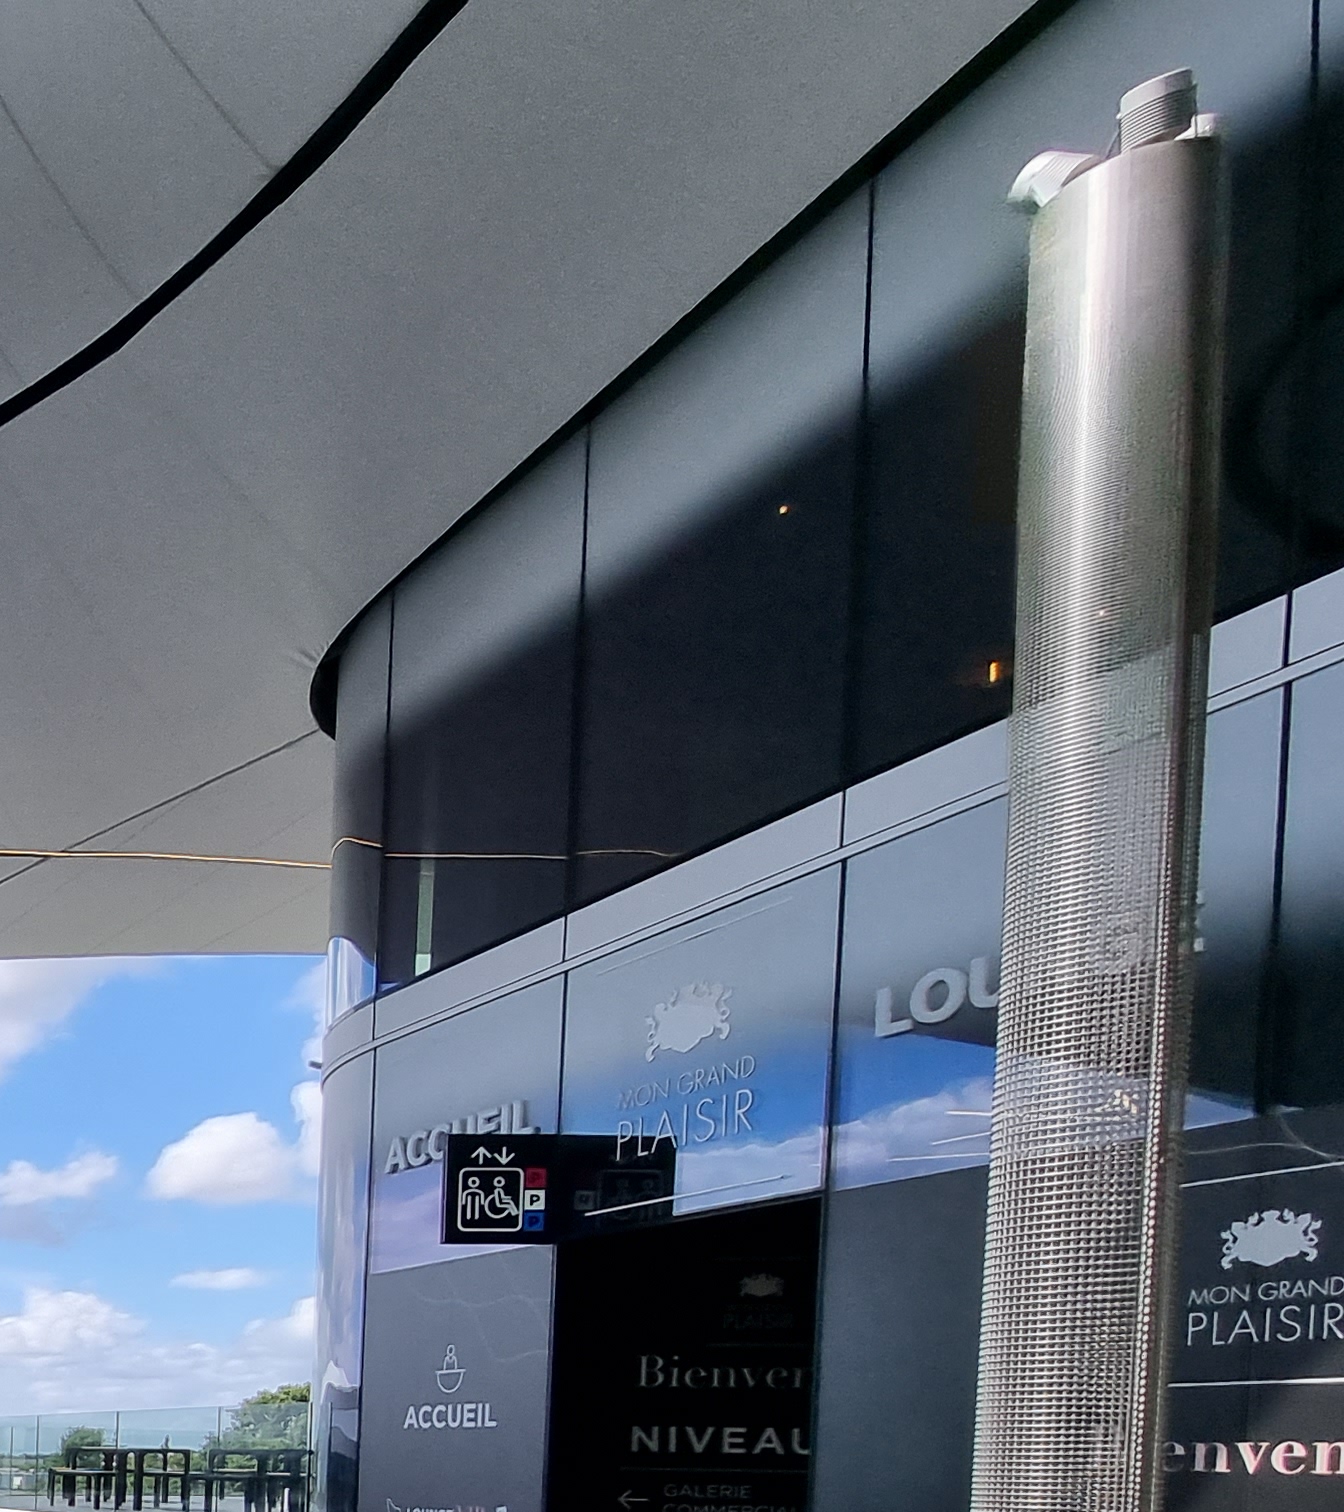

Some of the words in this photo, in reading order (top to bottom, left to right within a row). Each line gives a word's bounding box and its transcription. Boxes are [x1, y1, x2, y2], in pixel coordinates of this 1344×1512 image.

[677, 1055, 755, 1095] GRAND
[615, 1088, 754, 1162] PLAISIR
[529, 1194, 541, 1206] P
[1187, 1284, 1251, 1307] MON
[1257, 1276, 1344, 1301] GRAND
[1186, 1302, 1344, 1347] PLAISIR
[404, 1403, 498, 1430] ACCUEIL
[630, 1425, 811, 1455] NIVEAU
[663, 1484, 753, 1499] GALERIE
